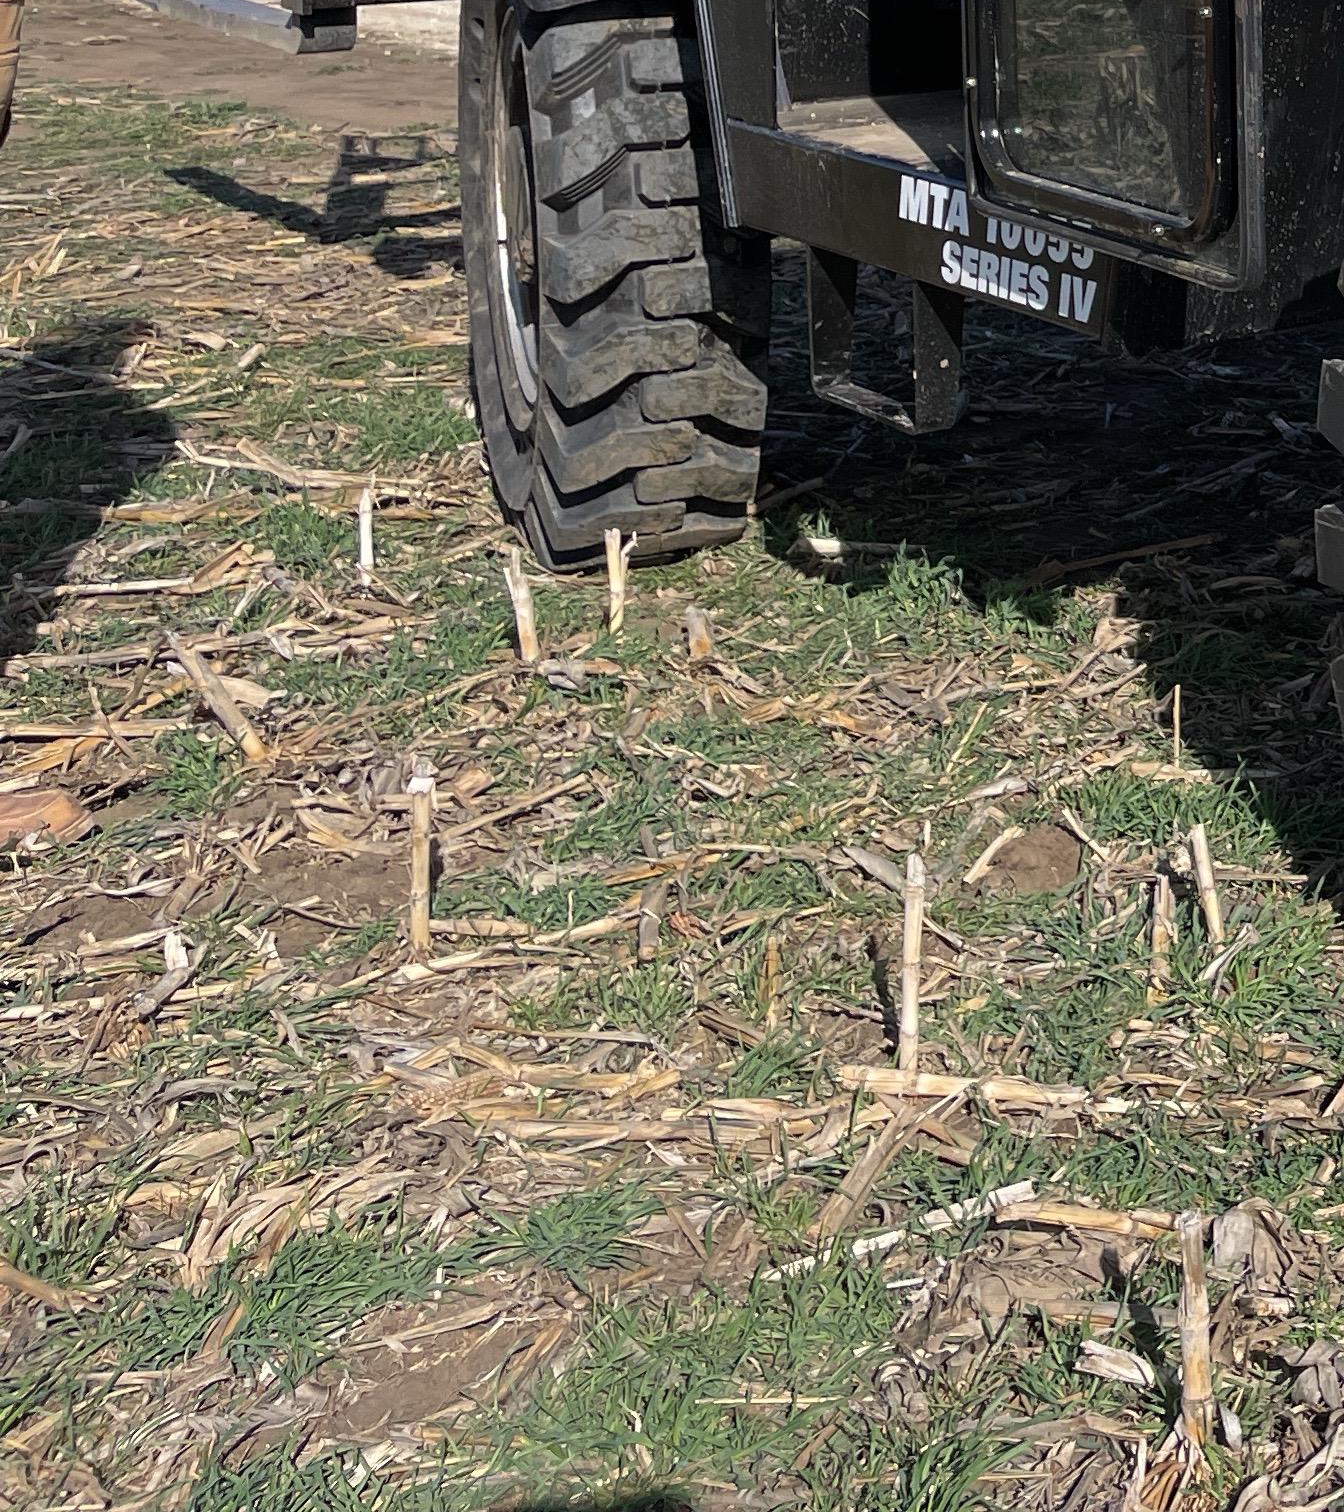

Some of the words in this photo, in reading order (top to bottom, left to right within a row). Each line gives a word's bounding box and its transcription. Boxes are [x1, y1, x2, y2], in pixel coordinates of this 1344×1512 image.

[898, 174, 970, 236] MTA
[940, 240, 1049, 311] SERIES
[1057, 273, 1097, 324] IV
